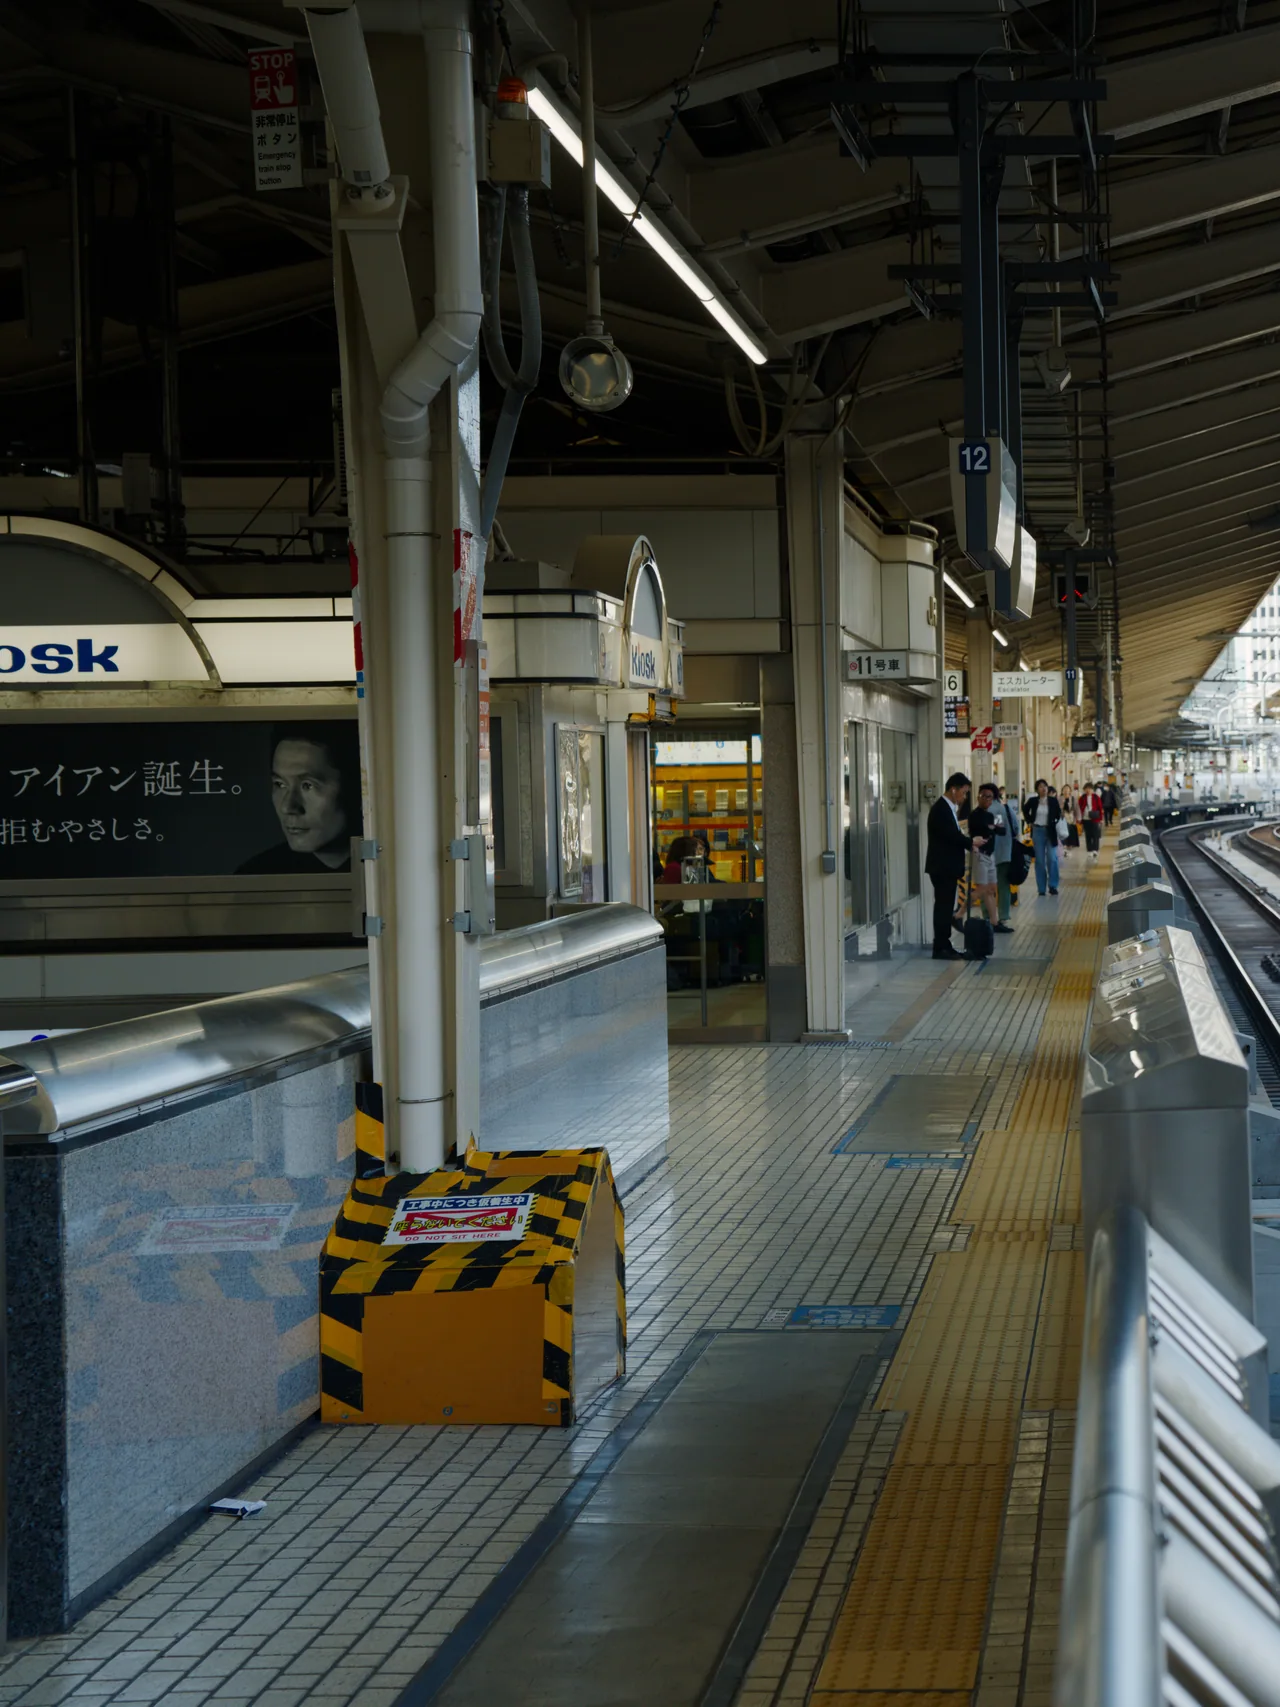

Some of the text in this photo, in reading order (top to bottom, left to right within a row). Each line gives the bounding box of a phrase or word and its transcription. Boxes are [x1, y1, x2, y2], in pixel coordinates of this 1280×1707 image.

[250, 52, 294, 70] STOP
[256, 113, 297, 128] 非常停止
[258, 151, 296, 161] Emergency
[258, 163, 291, 173] train stop
[259, 177, 282, 185] button
[961, 446, 988, 470] 12
[631, 642, 656, 679] Kiosk
[856, 655, 900, 674] 11号車
[997, 676, 1056, 685] エスカレーター
[1066, 670, 1075, 679] 11
[9, 758, 242, 798] アイアン誕生。
[0, 816, 164, 846] 拒むやさしさ。
